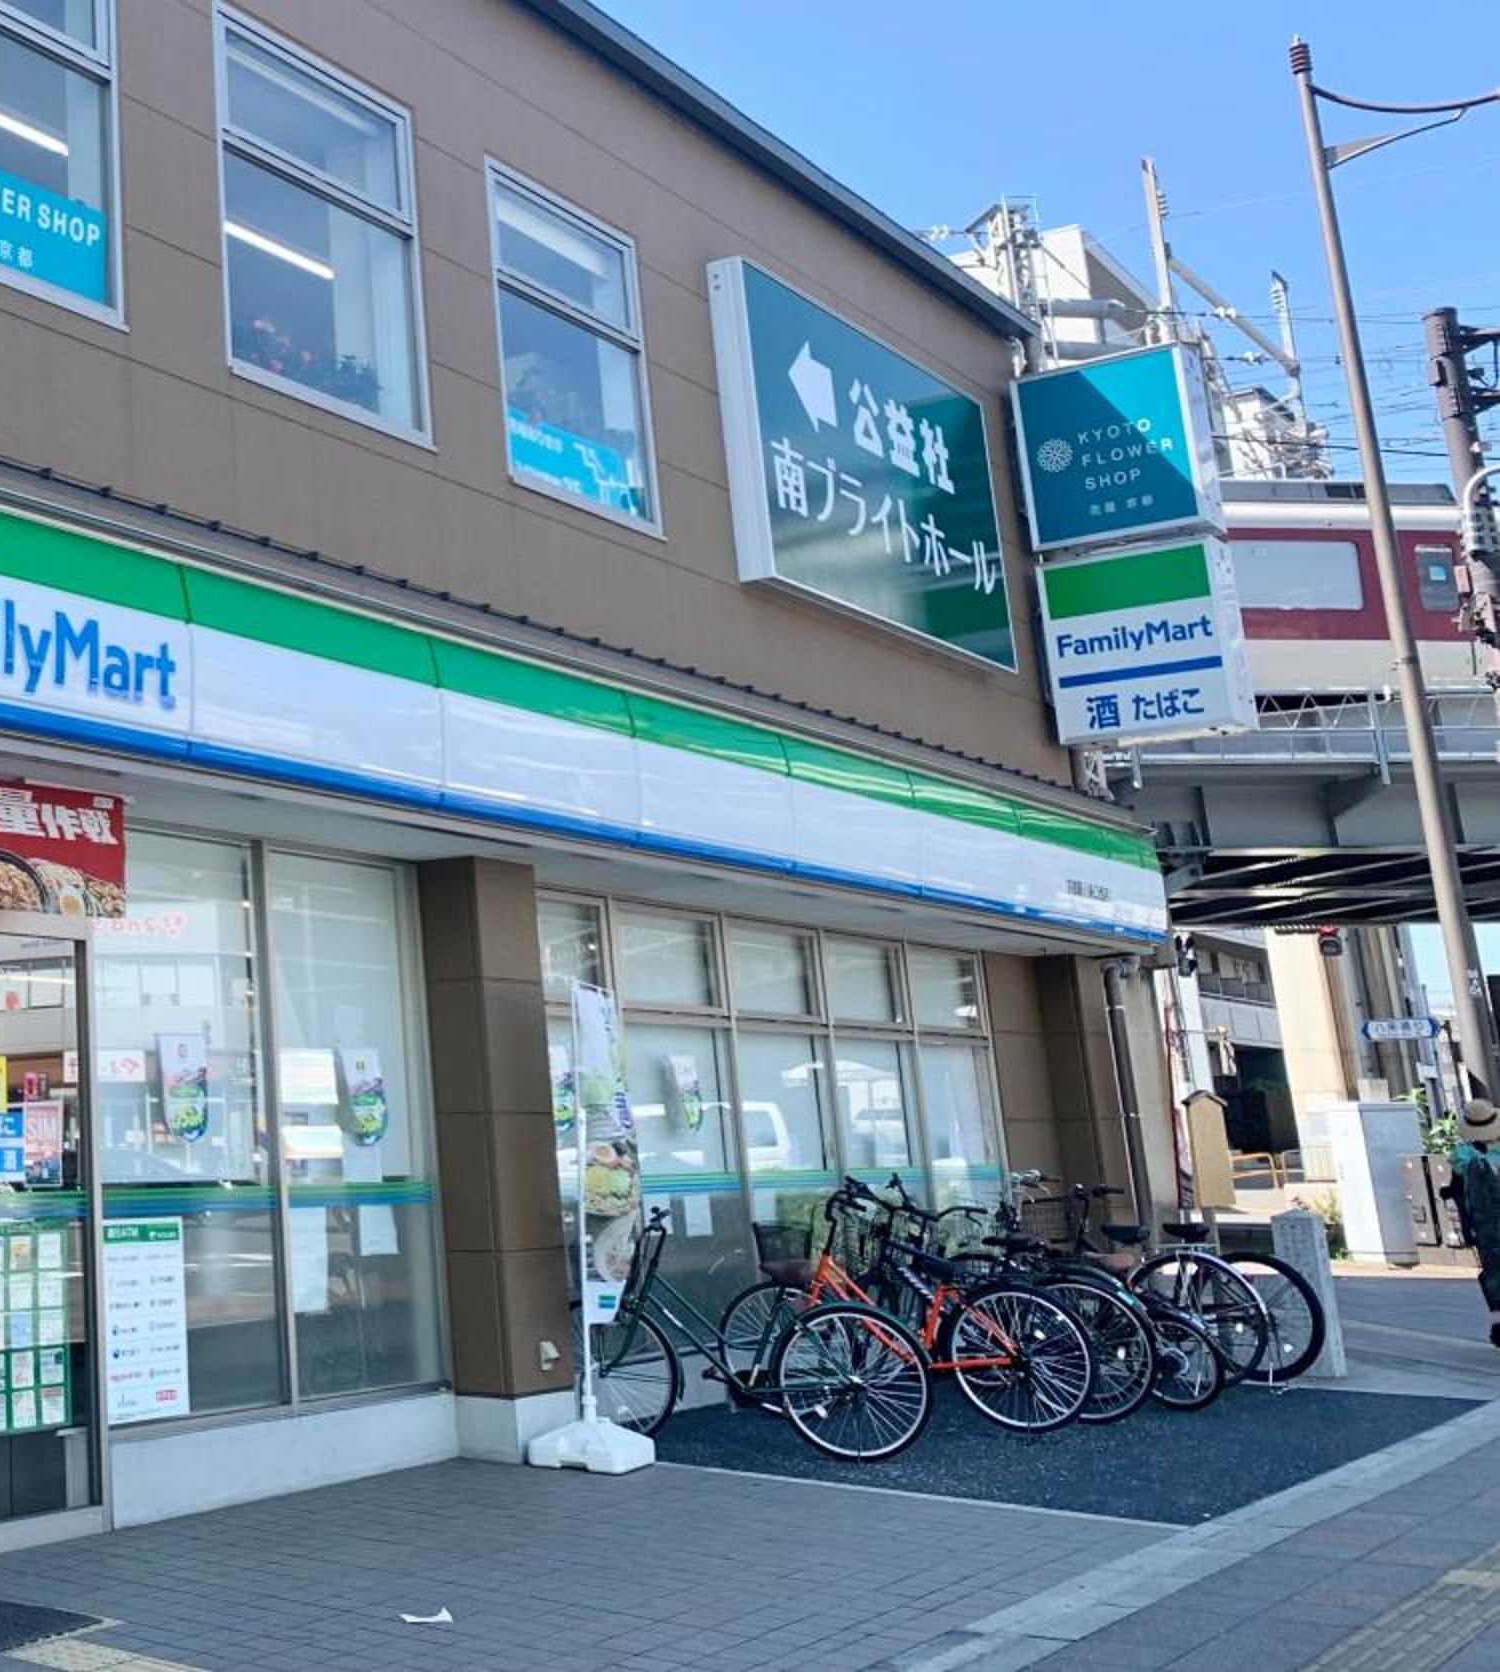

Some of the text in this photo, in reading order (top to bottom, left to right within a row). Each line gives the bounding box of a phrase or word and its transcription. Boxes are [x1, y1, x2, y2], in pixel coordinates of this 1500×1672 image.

[36, 200, 101, 248] SHOP
[848, 376, 955, 495] 公益社
[1077, 417, 1152, 445] KYOTO
[1081, 436, 1173, 468] FLOWER
[1085, 467, 1141, 492] SHOP
[770, 436, 1000, 595] 南ブライトホール
[1056, 614, 1214, 660] FamilyMart
[1086, 686, 1205, 730] 酒 たばこ
